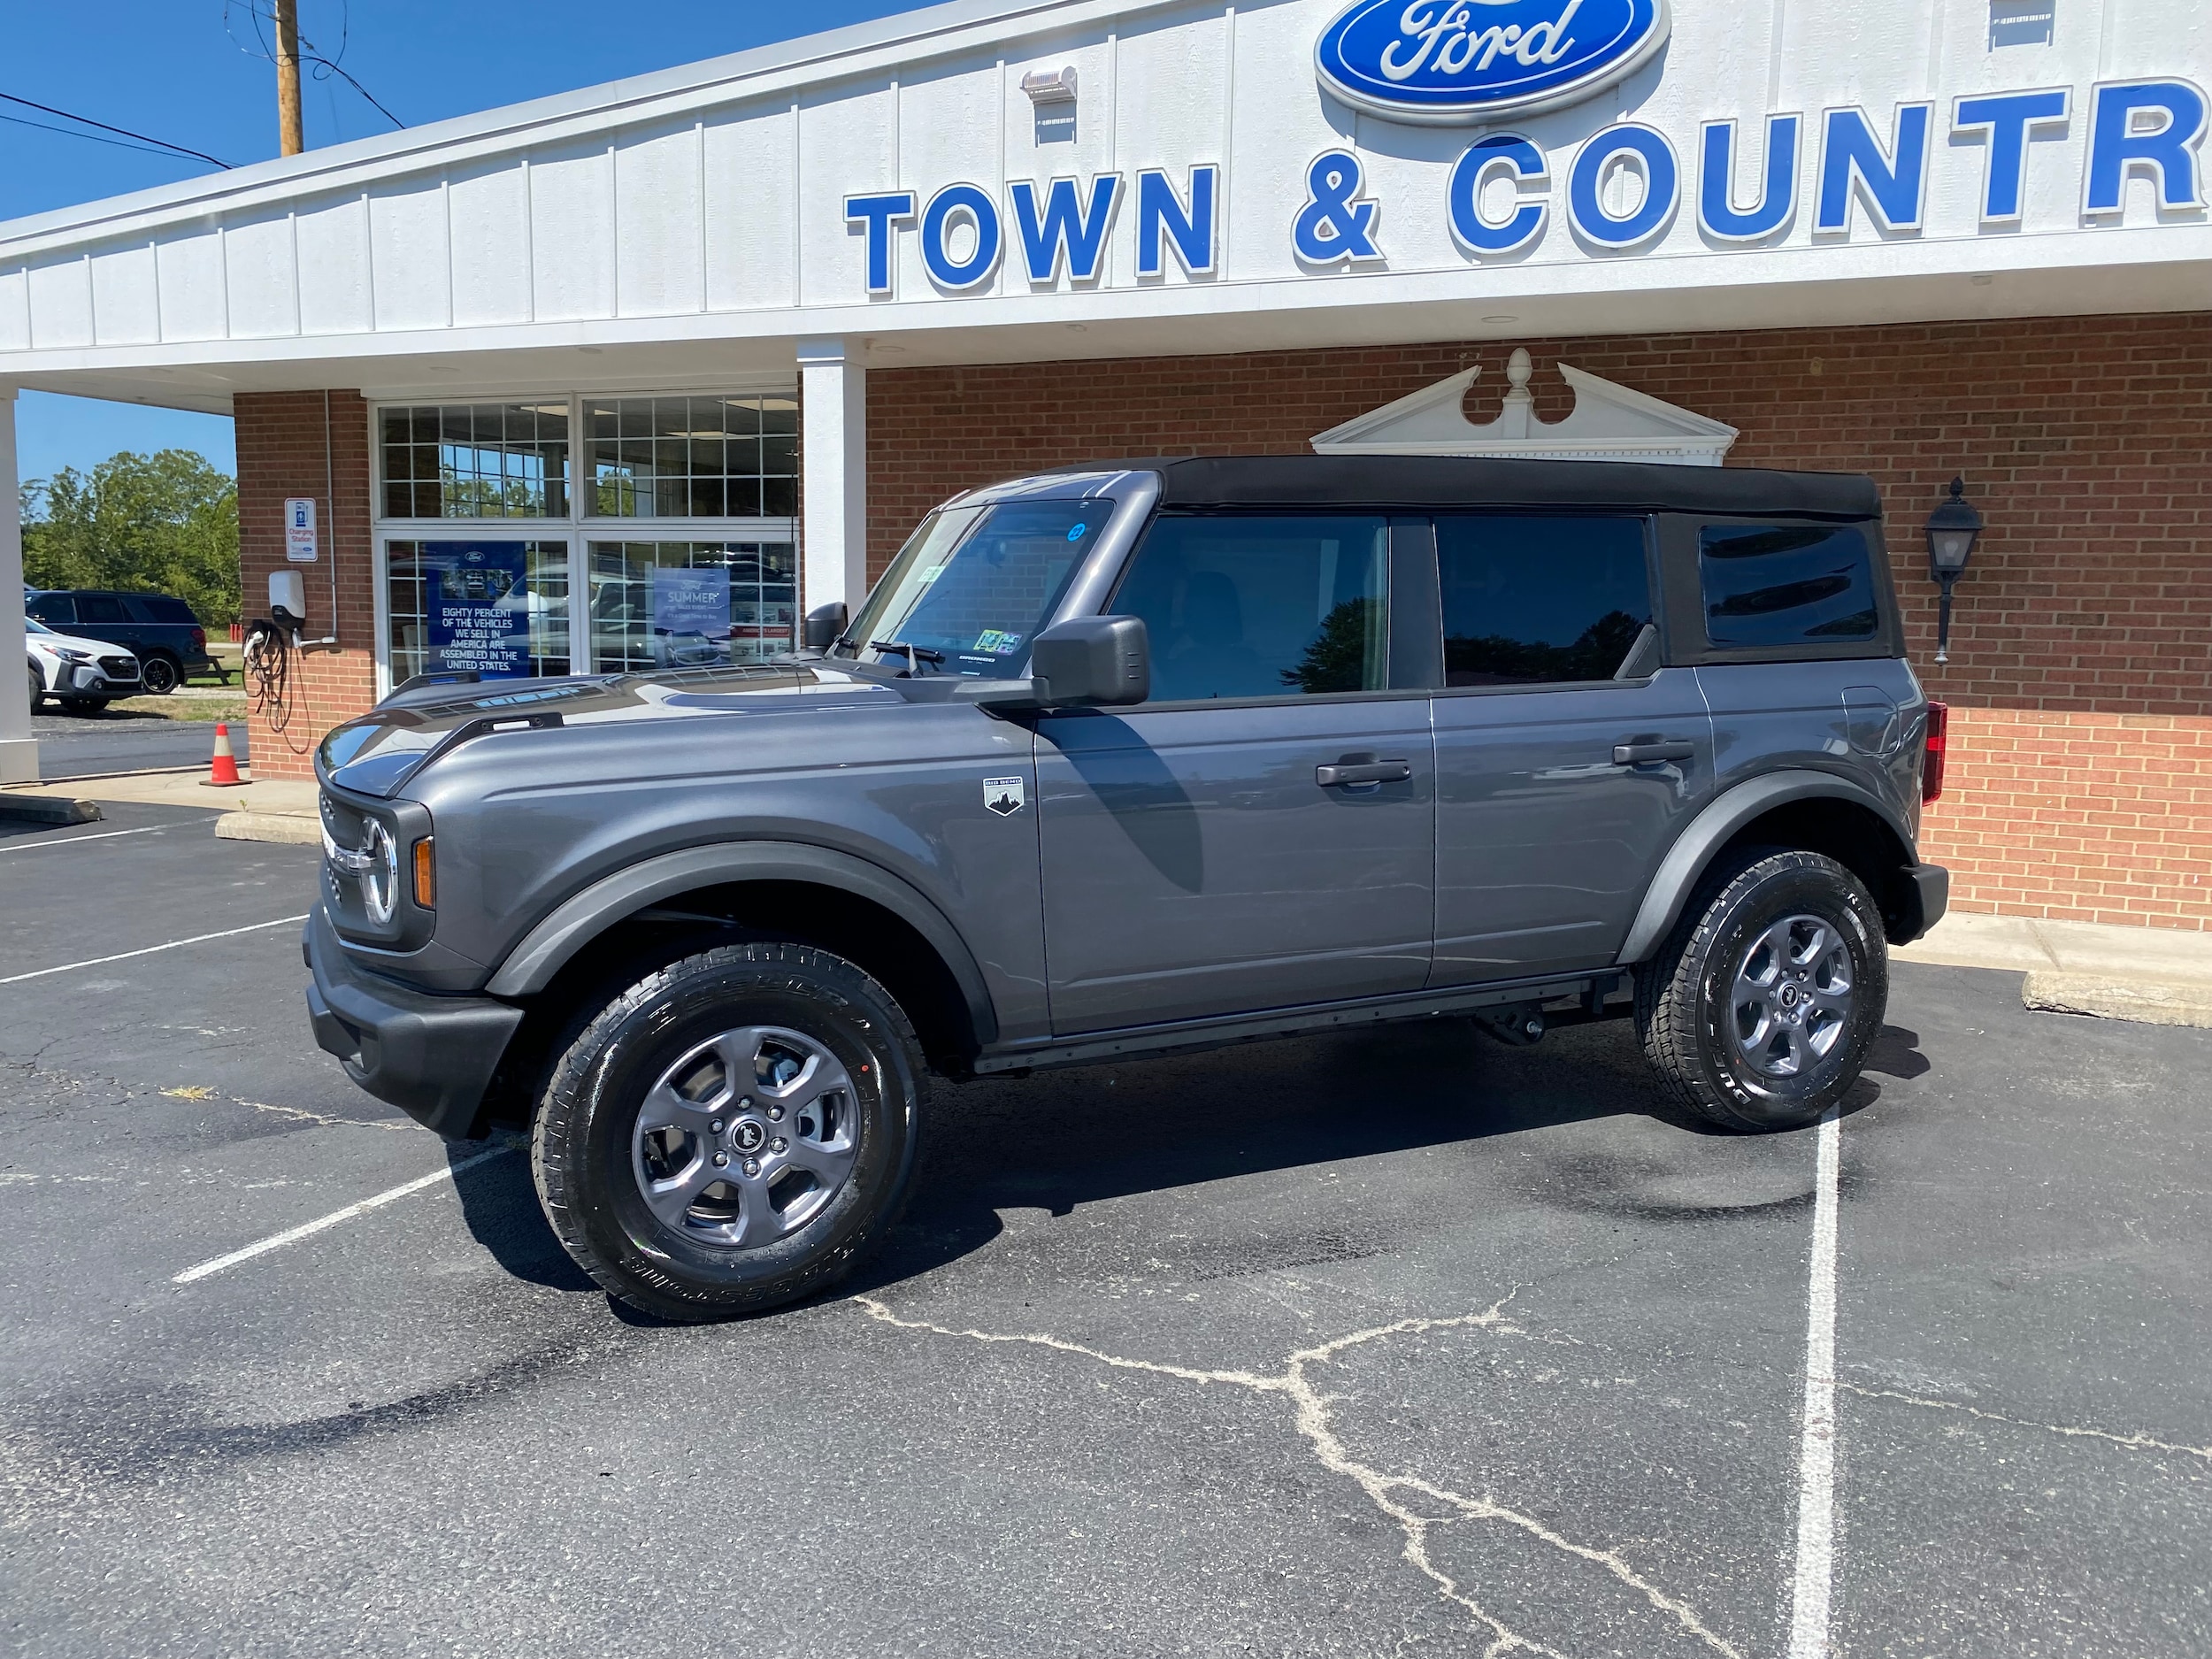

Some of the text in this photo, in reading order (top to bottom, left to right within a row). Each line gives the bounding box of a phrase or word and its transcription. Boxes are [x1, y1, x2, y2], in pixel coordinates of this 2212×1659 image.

[1380, 0, 1576, 81] Ford
[843, 77, 2210, 295] TOWN & COUNTR
[667, 592, 716, 603] SUMMER
[442, 608, 511, 618] EIGHTY PERCENT
[442, 618, 512, 628] OF THE VEHICLES
[455, 629, 501, 639] WE SELL IN
[450, 640, 505, 649] AMERICA ARE
[440, 649, 518, 660] ASSEMBLED IN THE
[447, 660, 511, 671] UNITED STATES.
